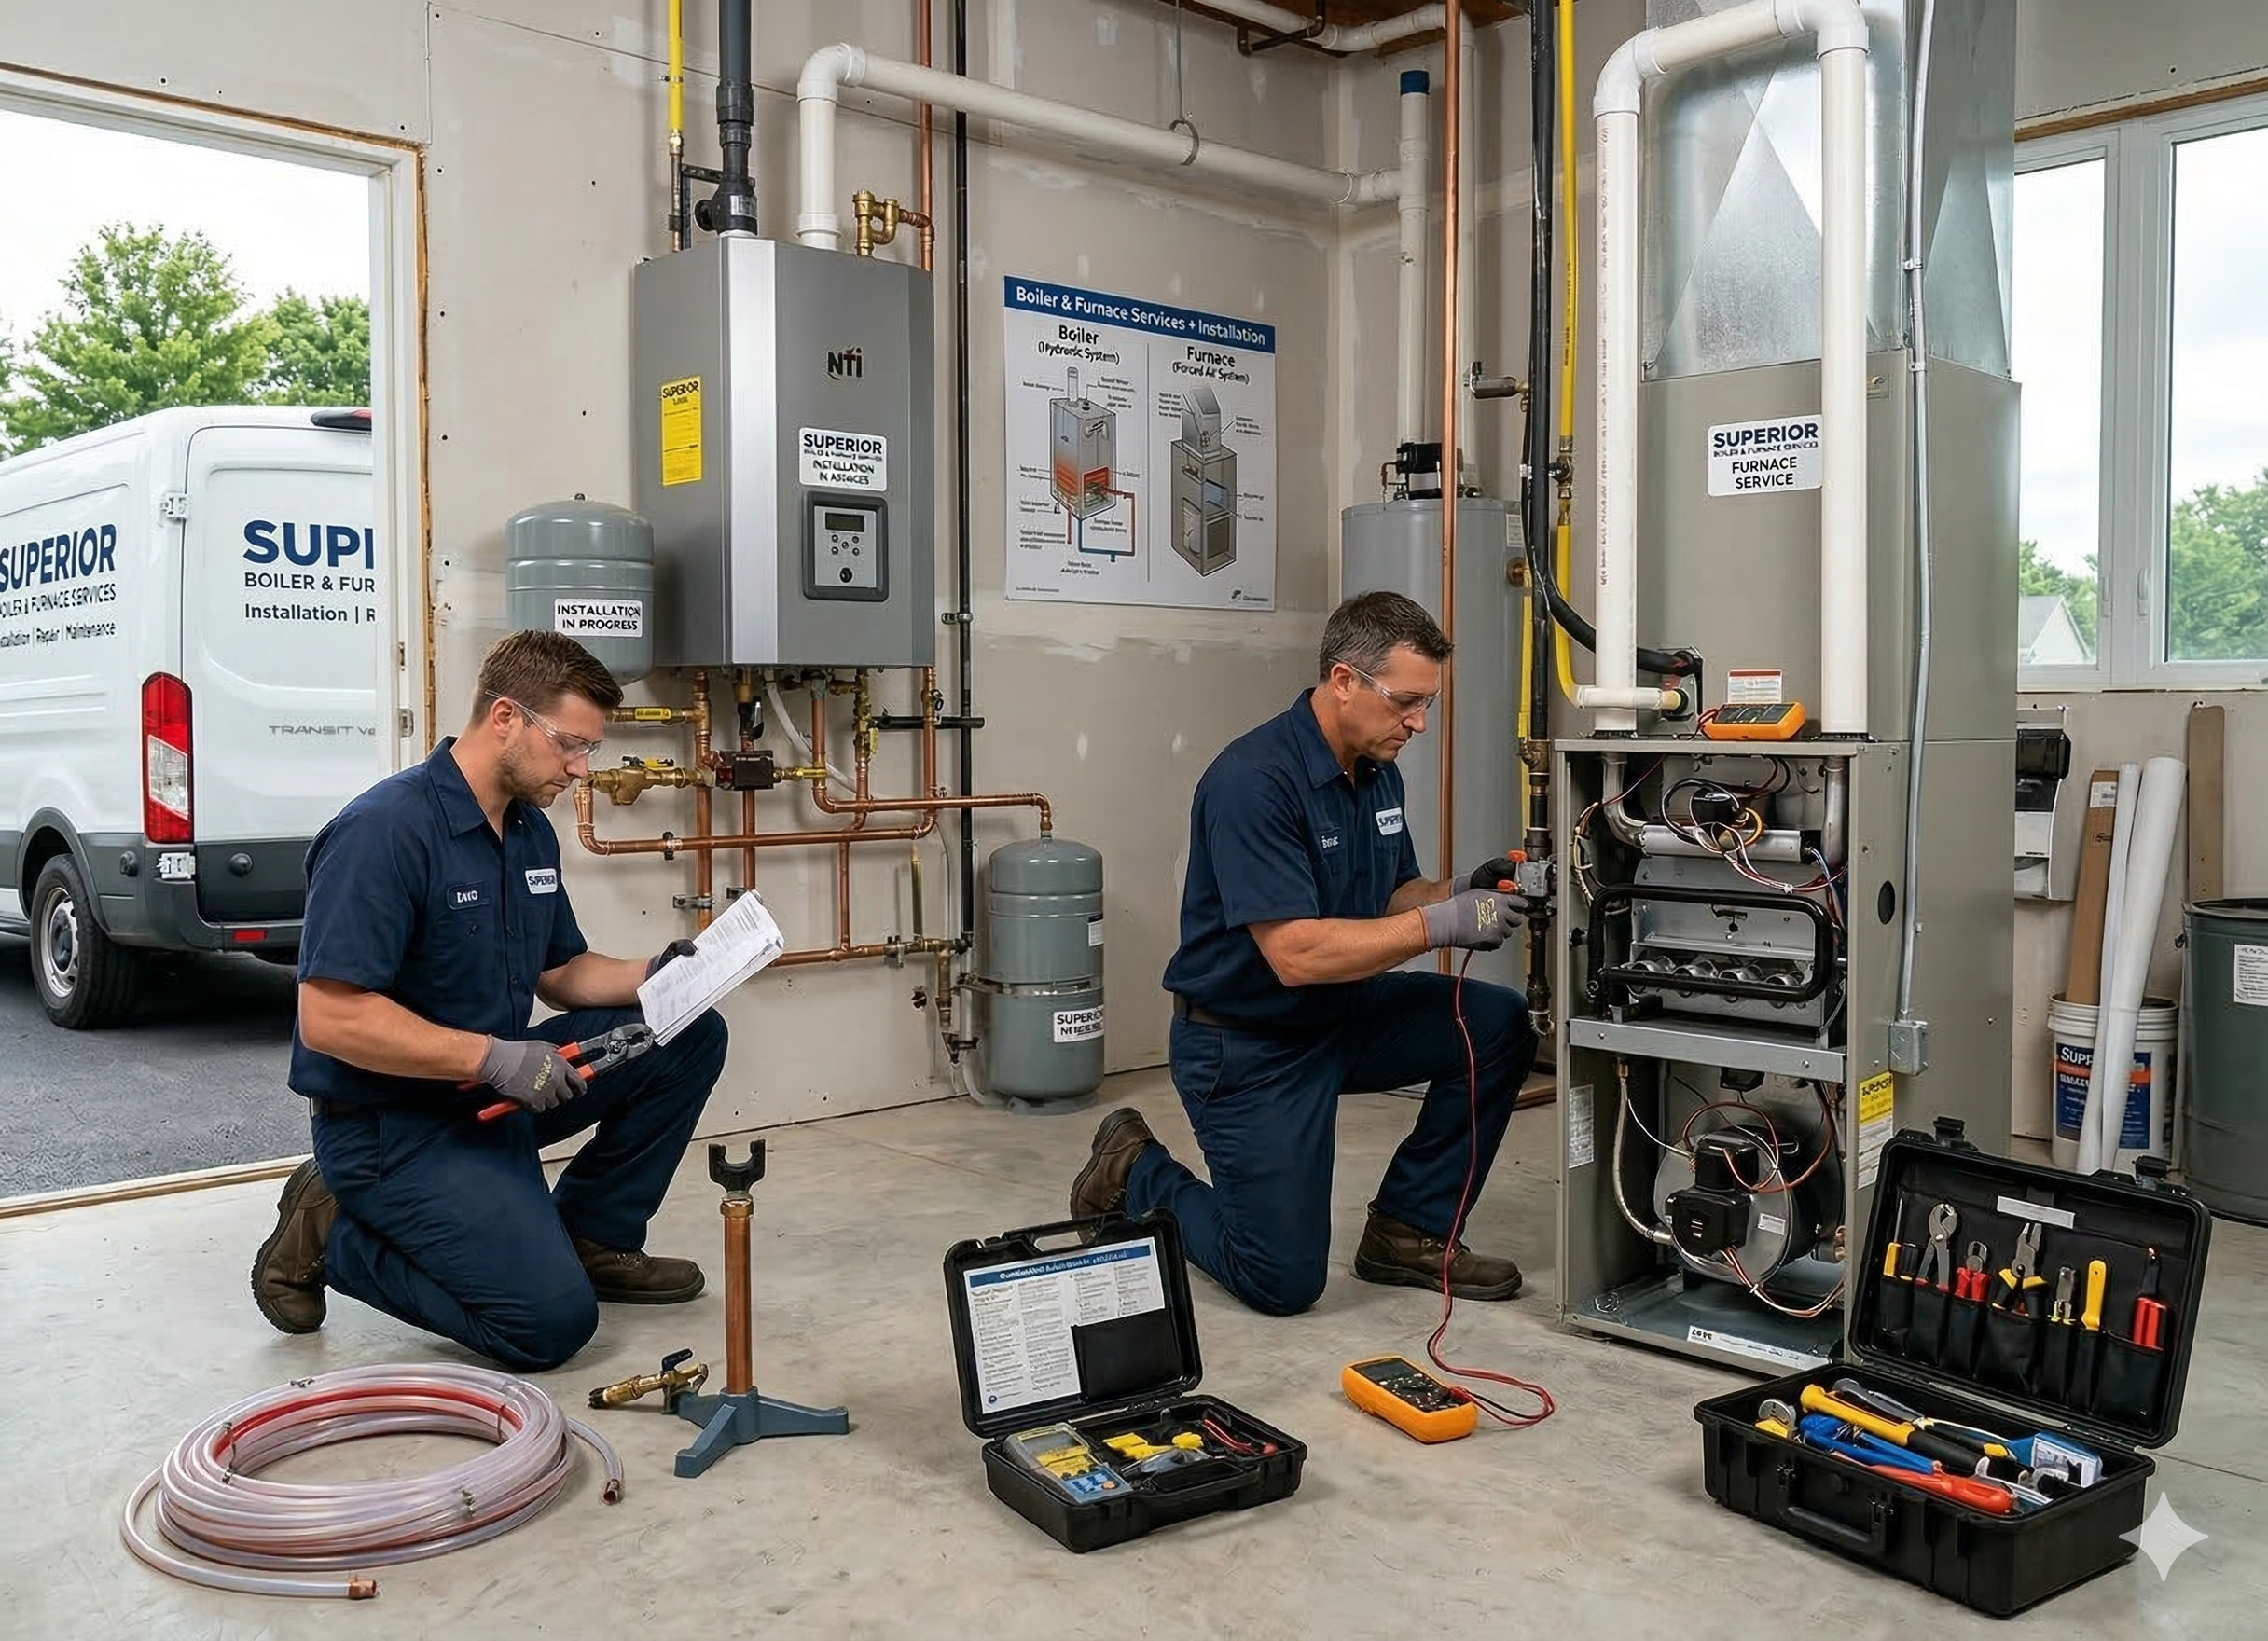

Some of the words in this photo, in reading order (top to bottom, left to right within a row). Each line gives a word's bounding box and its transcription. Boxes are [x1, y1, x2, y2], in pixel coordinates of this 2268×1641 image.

[1016, 285, 1058, 308] Boiler
[1061, 295, 1072, 310] &
[1074, 296, 1128, 321] Furnace
[1131, 308, 1186, 330] Services
[1198, 319, 1265, 345] Installation
[1058, 324, 1099, 345] Boiler
[1187, 346, 1236, 367] Furnace
[803, 434, 883, 455] SUPERIOR
[1713, 422, 1819, 448] SUPERIOR
[1732, 456, 1798, 474] FURNACE
[1735, 473, 1794, 490] SERVICE
[0, 523, 117, 593] SUPERIOR
[244, 572, 315, 590] BOILER
[321, 575, 334, 591] &
[339, 576, 375, 593] FUR
[245, 603, 348, 623] Installation
[557, 604, 641, 617] INSTALLATION
[562, 619, 575, 629] IN
[579, 619, 638, 631] PROGRESS
[269, 725, 353, 736] TRANSIT
